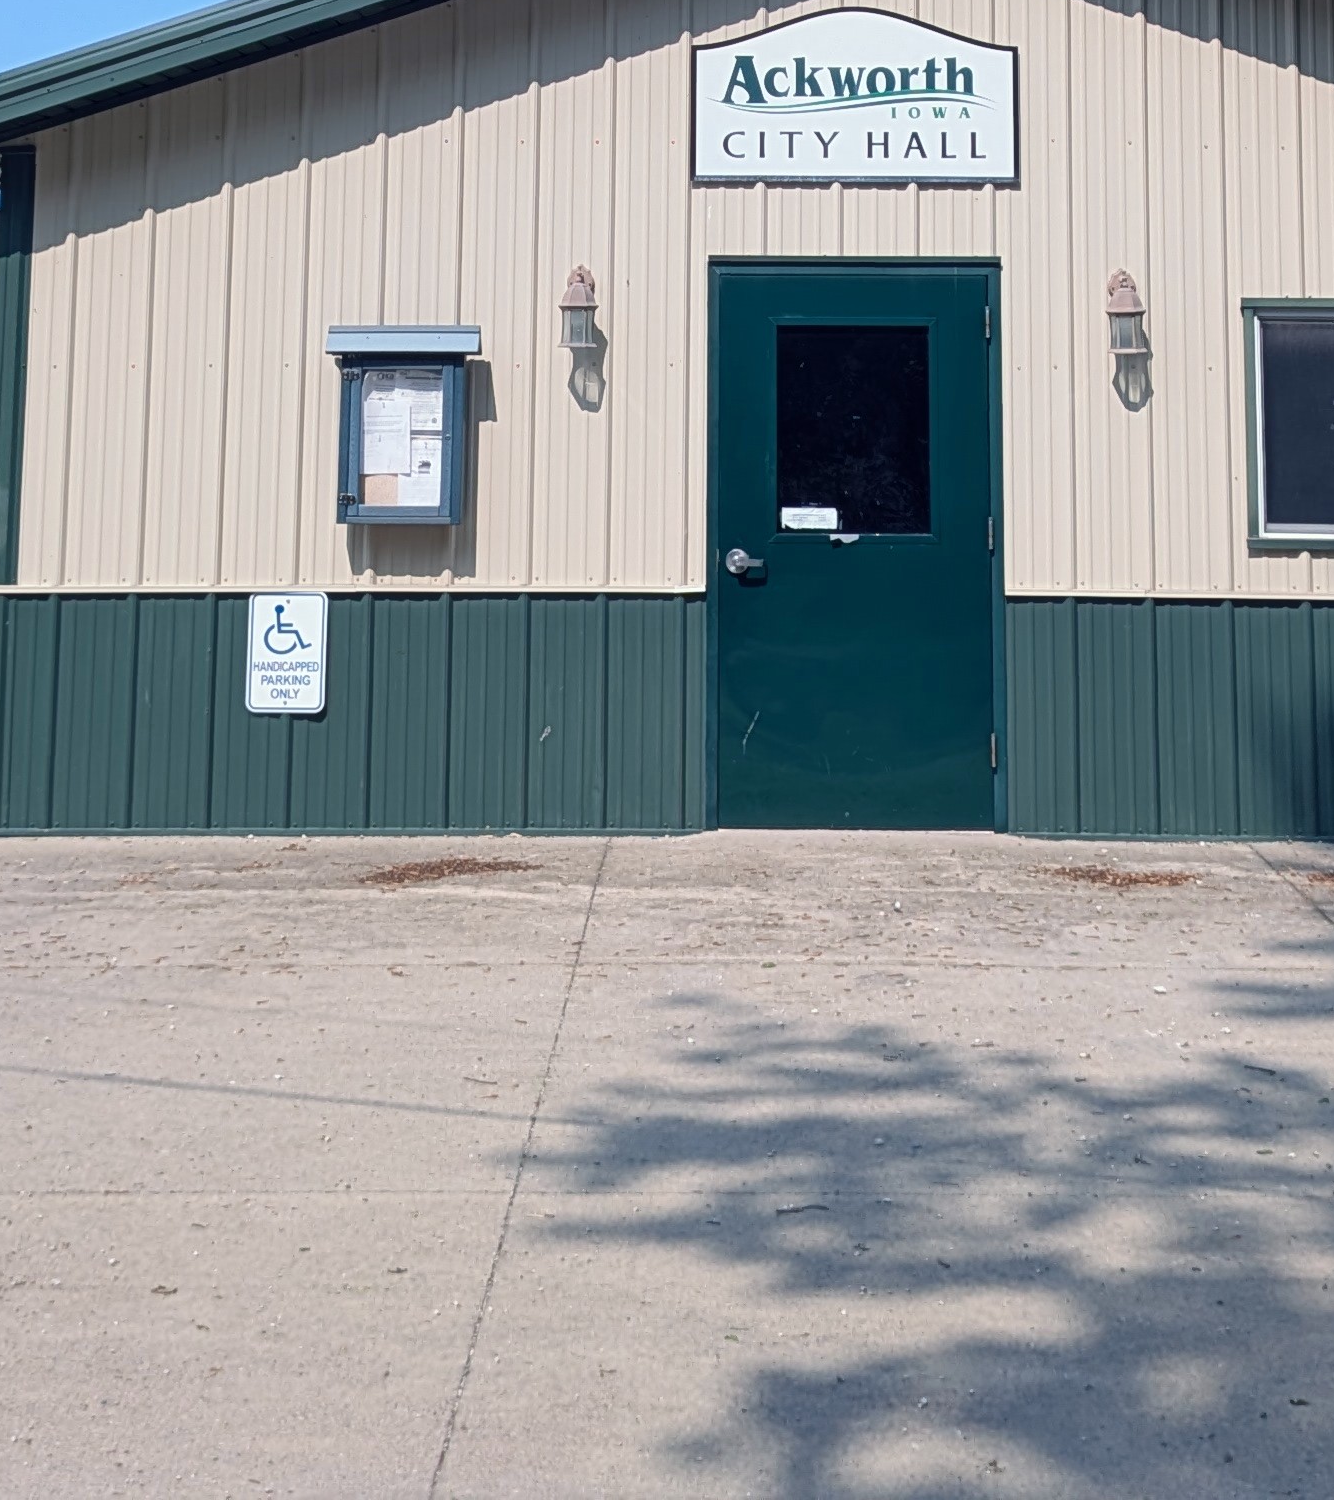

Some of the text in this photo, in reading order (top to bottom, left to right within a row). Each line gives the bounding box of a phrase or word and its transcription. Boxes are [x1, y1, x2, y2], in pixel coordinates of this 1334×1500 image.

[722, 55, 975, 104] Ackworth
[890, 106, 971, 119] IOWA
[722, 131, 987, 159] CITY HALL
[253, 661, 319, 672] HANDICAPPED
[260, 675, 311, 686] PARKING
[270, 688, 300, 699] ONLY
